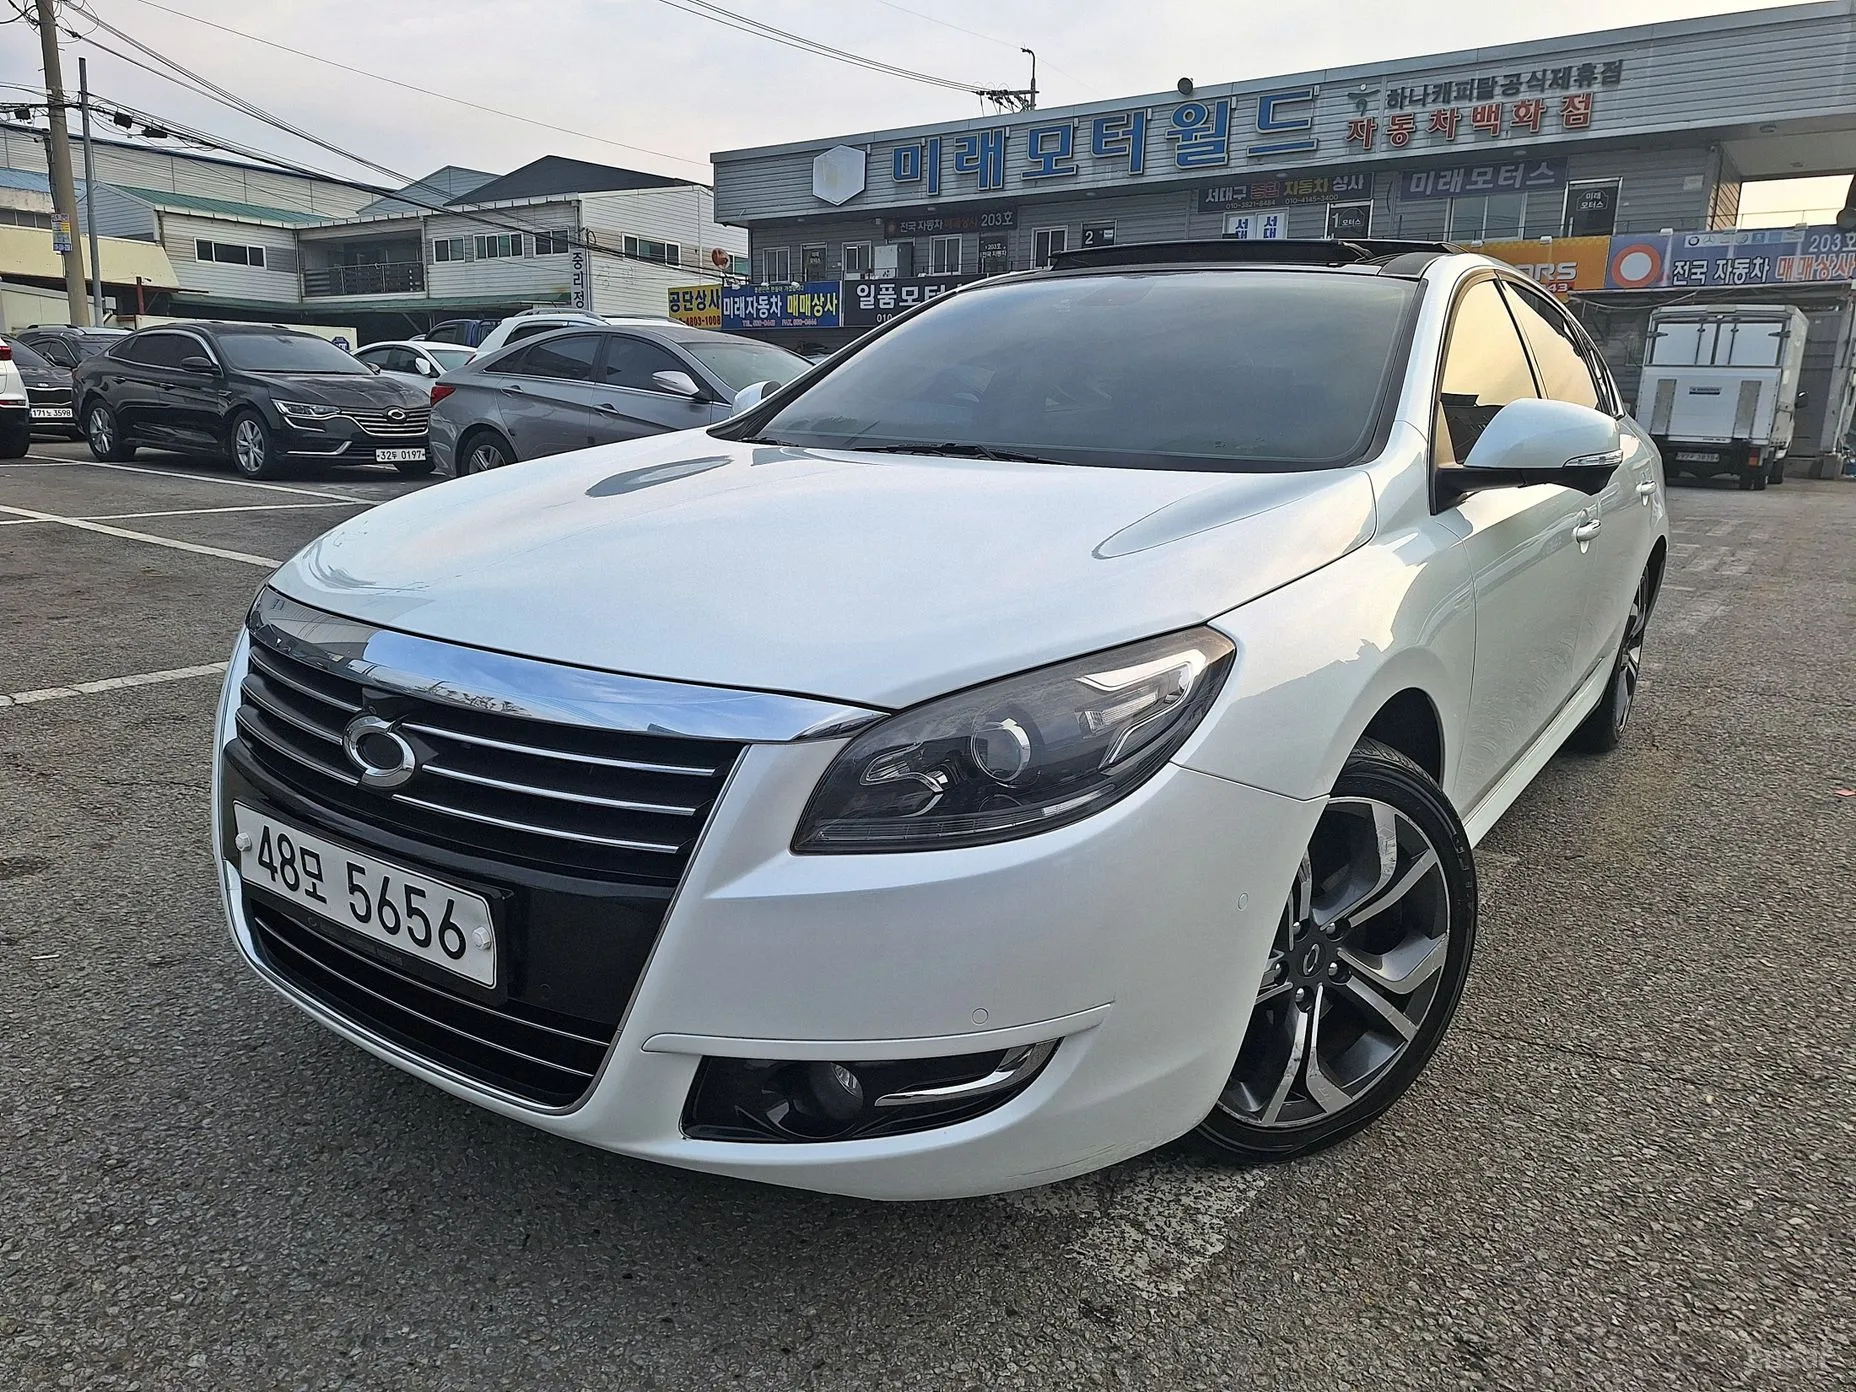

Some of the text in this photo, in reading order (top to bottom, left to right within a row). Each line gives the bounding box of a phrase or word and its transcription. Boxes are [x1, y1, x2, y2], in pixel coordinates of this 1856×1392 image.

[1345, 91, 1595, 150] 자동차백화점
[1205, 185, 1248, 203] 서대구
[1283, 177, 1330, 196] 자동차
[1332, 174, 1365, 191] 상사
[1409, 161, 1556, 194] 미래모터스
[981, 211, 1014, 227] 203호
[1085, 230, 1094, 245] 2
[1672, 252, 1856, 286] 전국 자동차 매매상사
[669, 288, 721, 313] 공단상사
[723, 292, 838, 319] 미래자동차 매매상사
[856, 282, 963, 310] 일품모터
[401, 450, 422, 460] 0197
[257, 824, 327, 905] 48모
[346, 860, 467, 960] 5656
